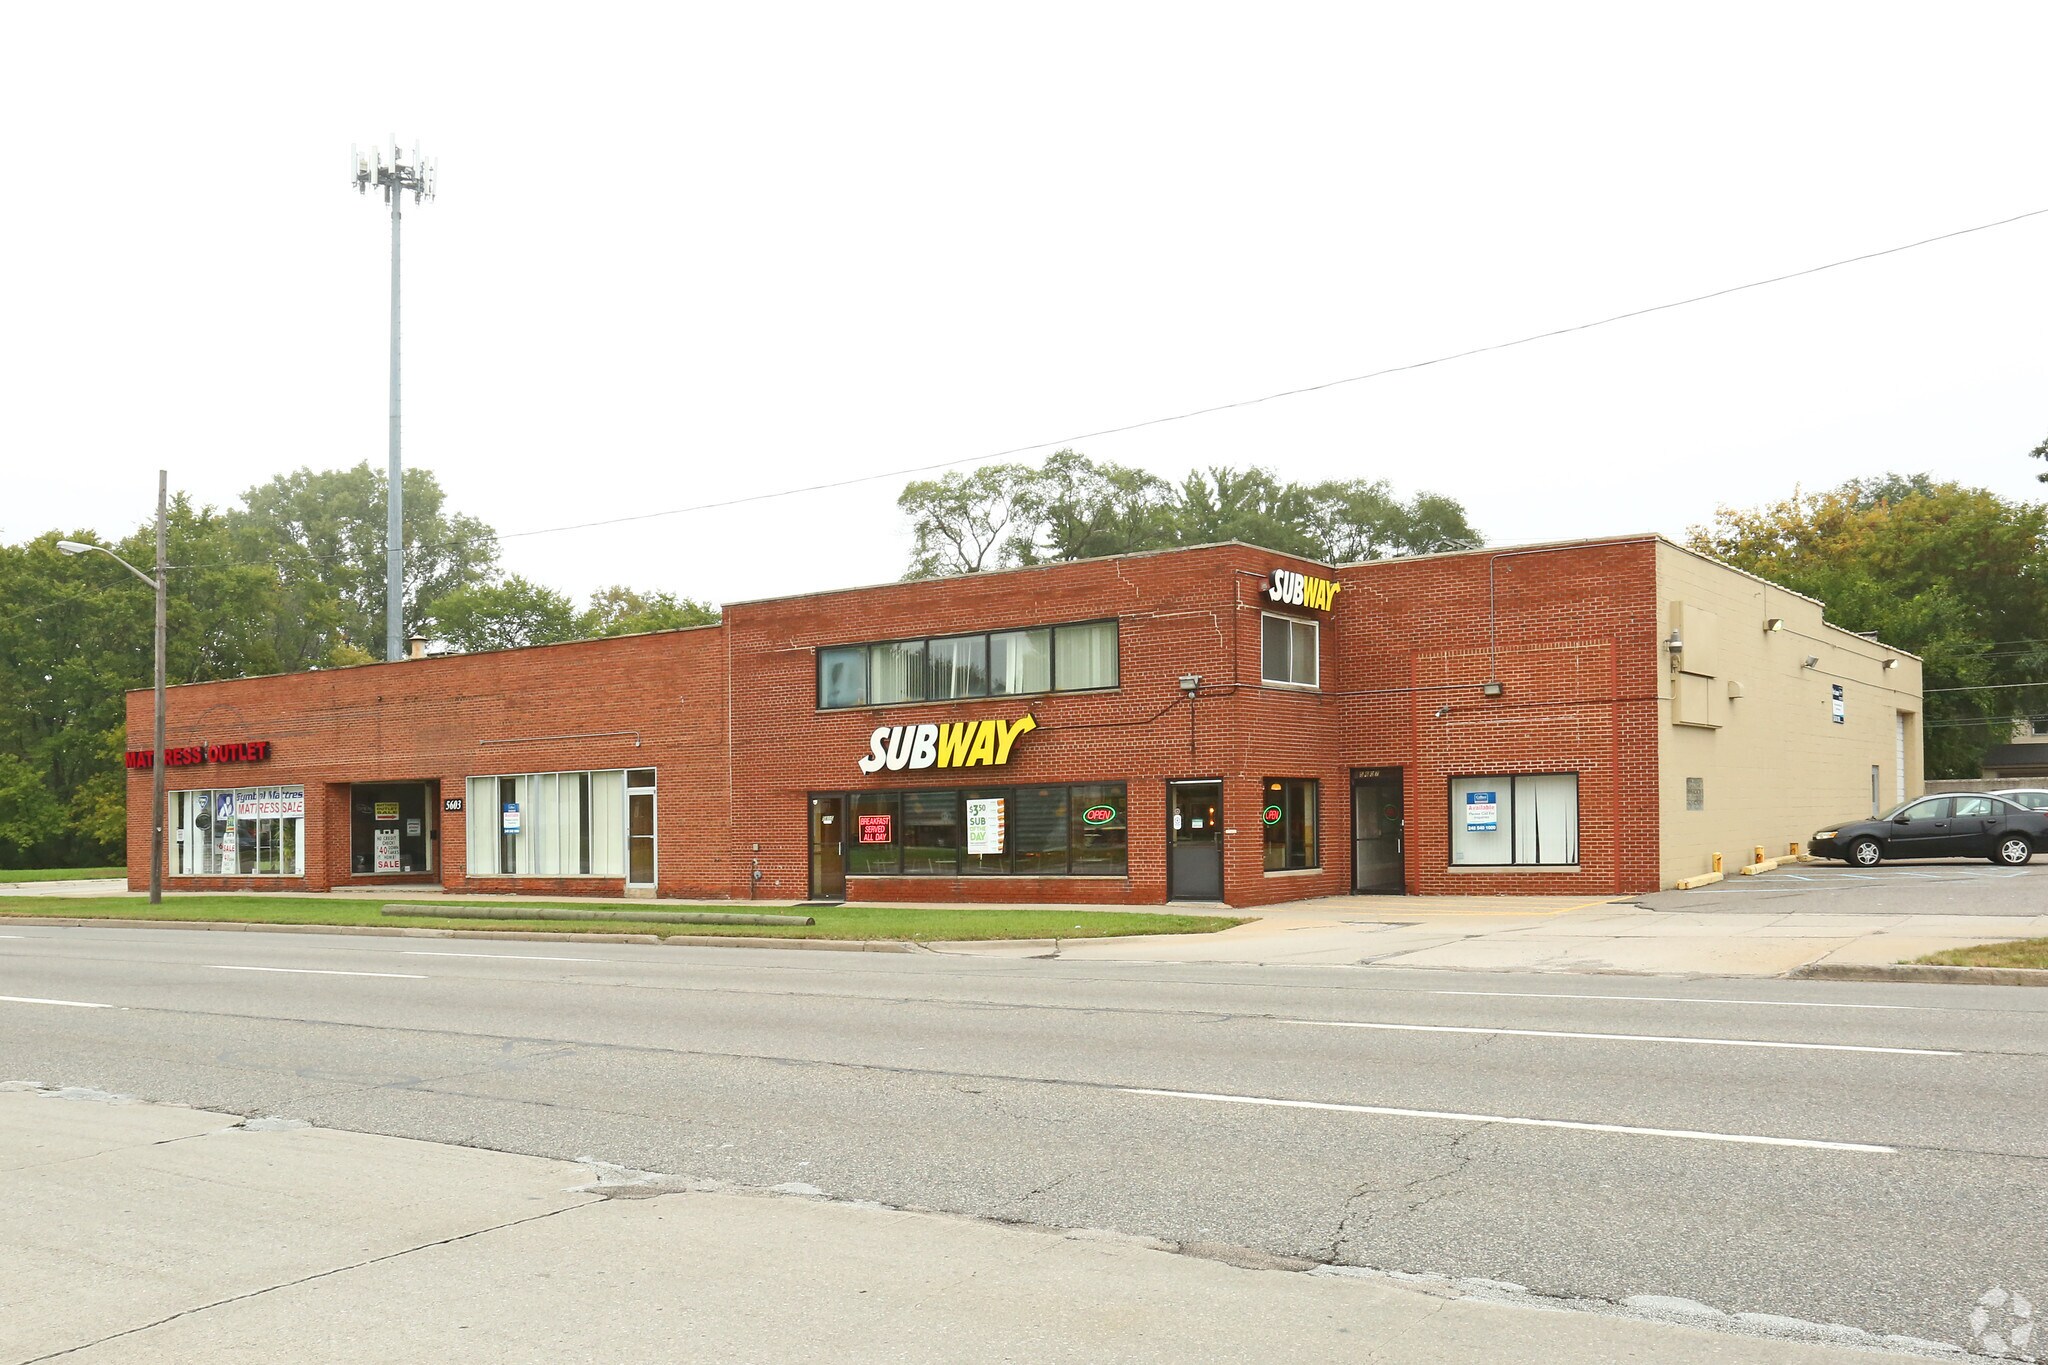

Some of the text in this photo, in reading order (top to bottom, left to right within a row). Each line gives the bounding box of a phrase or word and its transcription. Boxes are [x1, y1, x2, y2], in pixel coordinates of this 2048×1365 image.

[1269, 569, 1341, 611] SUBWAY
[858, 713, 1036, 775] SUBWAY
[125, 741, 267, 768] MATRESS OUTLET
[282, 801, 303, 813] SALE
[445, 800, 462, 810] 5603
[1087, 810, 1111, 820] OPEN
[1265, 810, 1279, 820] OPEN
[860, 817, 889, 825] BREAKFAST
[970, 817, 986, 826] SUB
[875, 833, 887, 841] DAY
[970, 832, 986, 841] DAY
[378, 860, 400, 869] SALE
